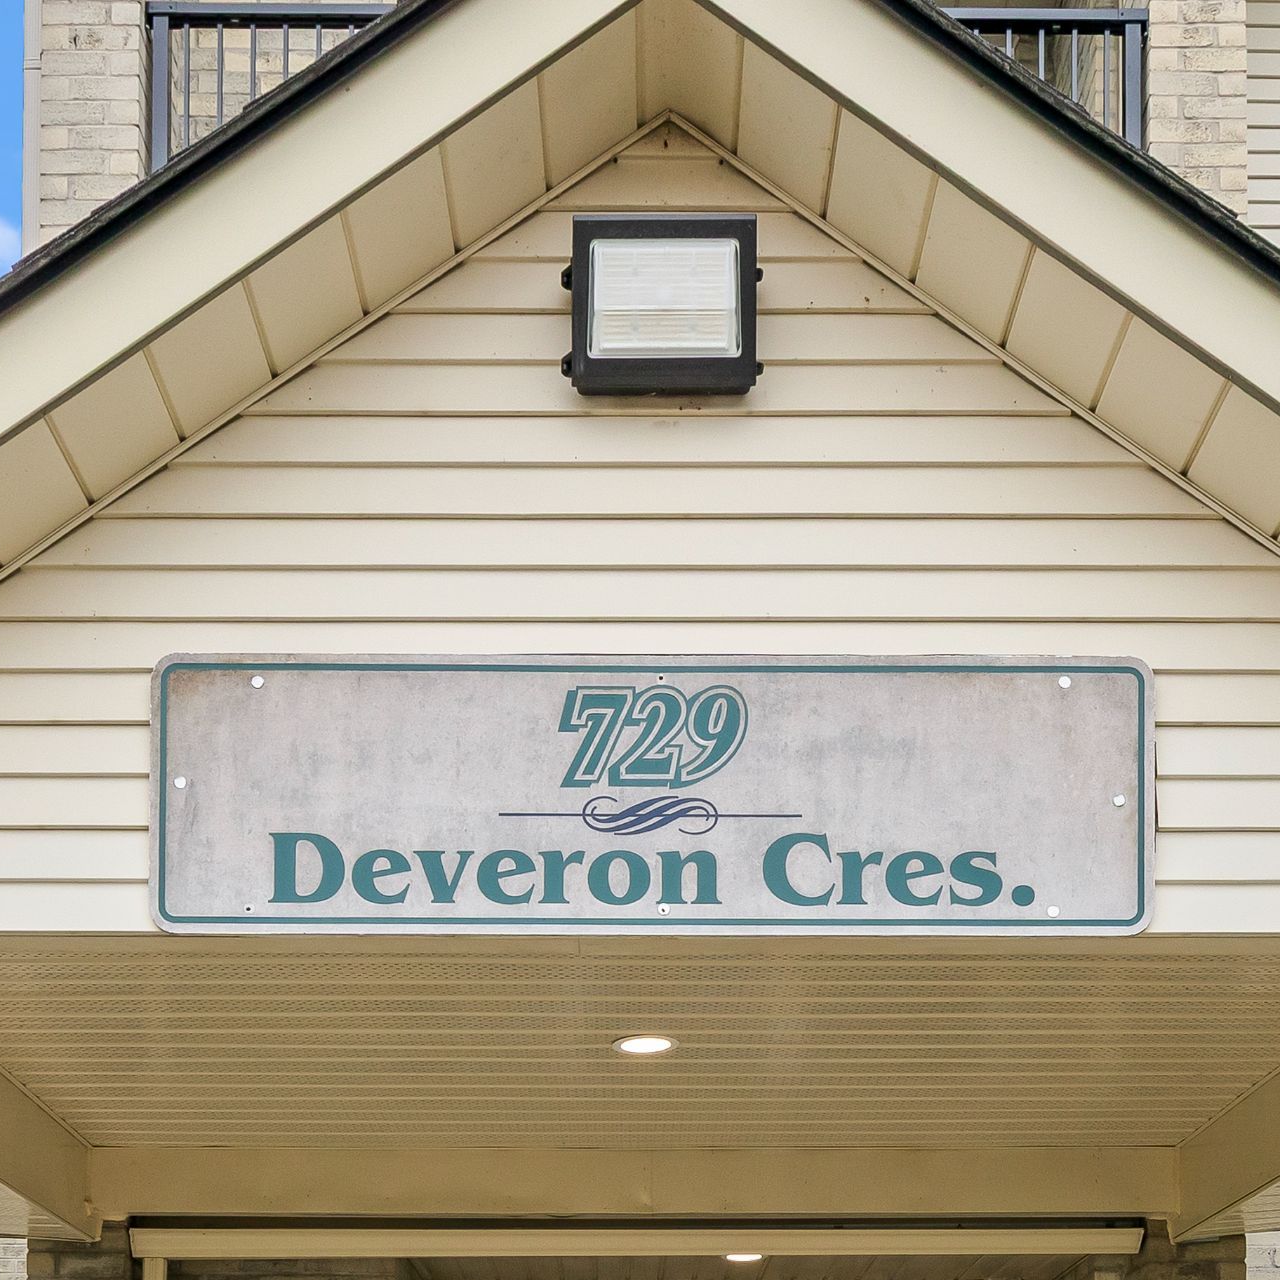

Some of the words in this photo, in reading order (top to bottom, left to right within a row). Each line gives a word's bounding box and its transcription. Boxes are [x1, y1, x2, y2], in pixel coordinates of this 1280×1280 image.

[558, 684, 749, 790] 729
[268, 831, 723, 907] Deveron
[762, 831, 1036, 907] Cres.
